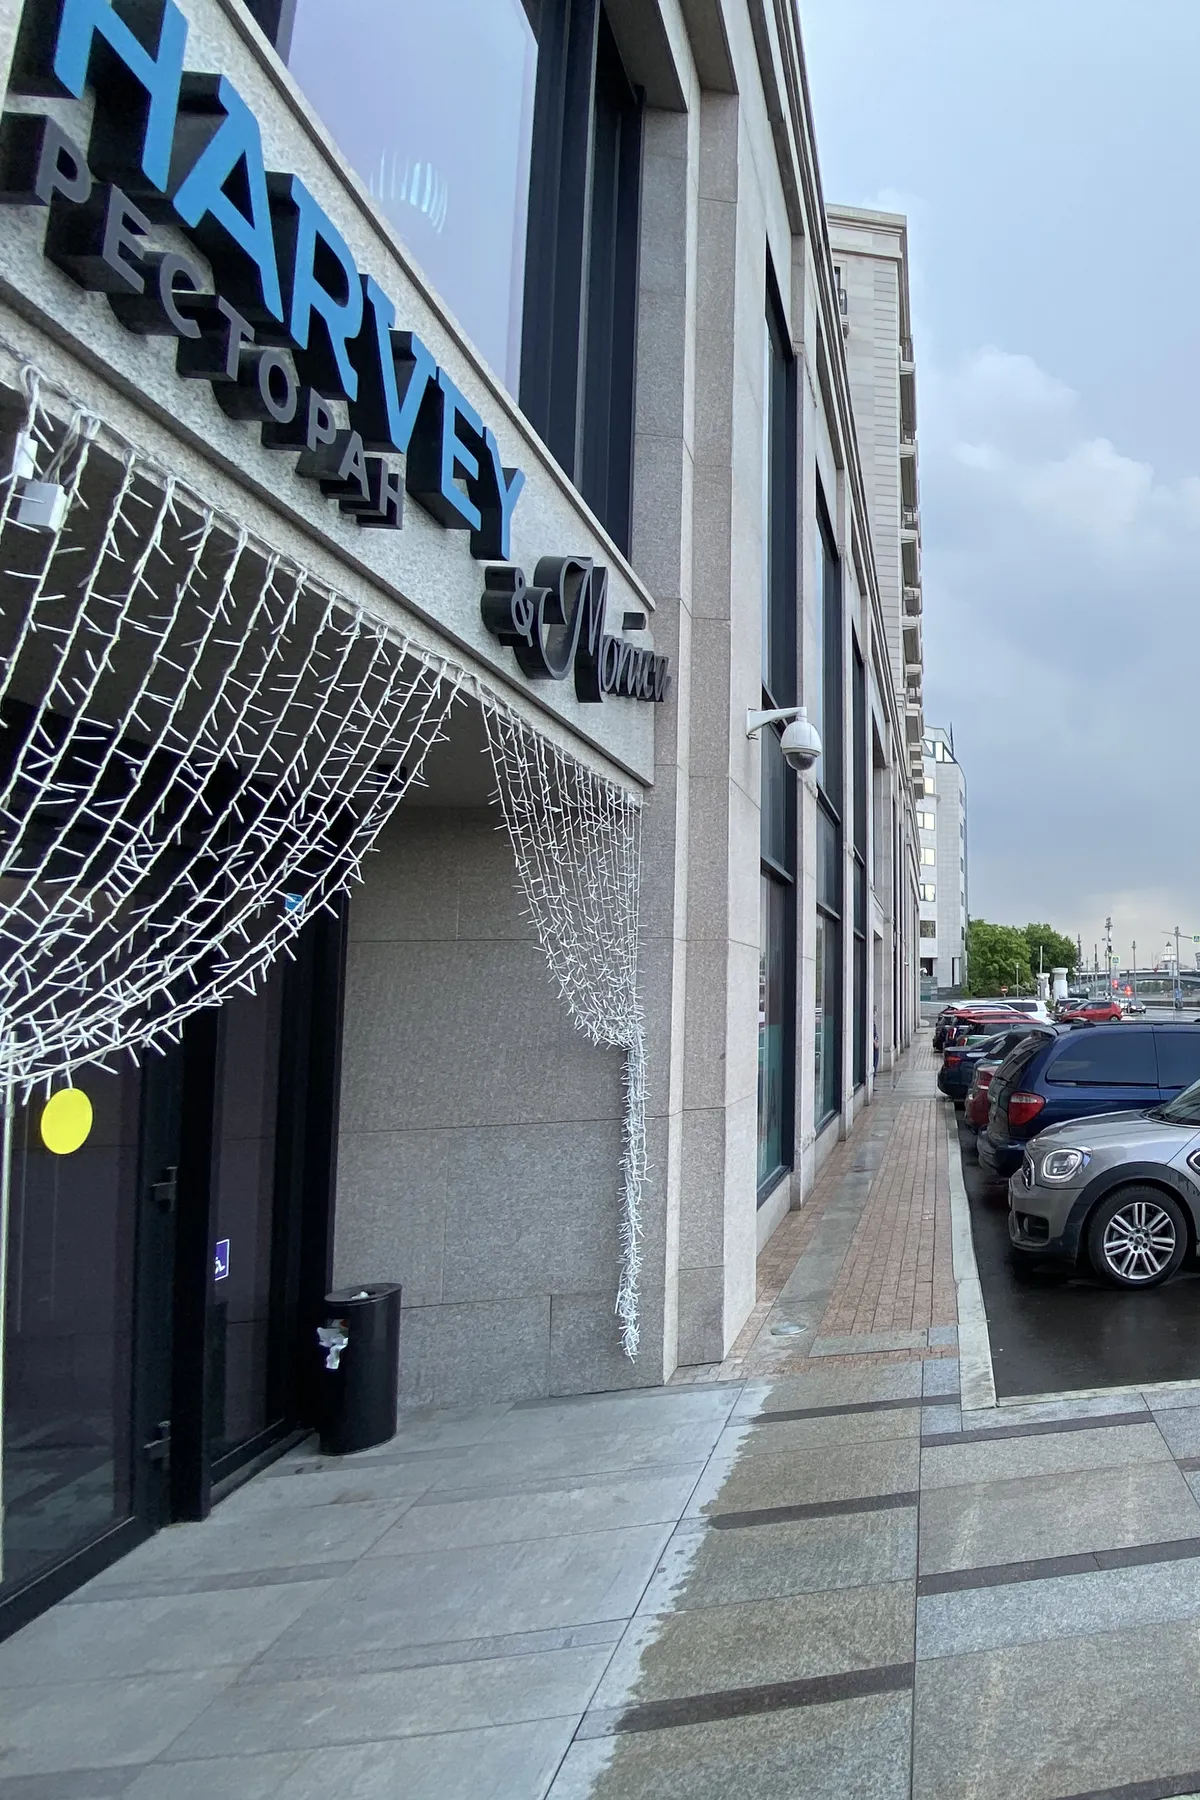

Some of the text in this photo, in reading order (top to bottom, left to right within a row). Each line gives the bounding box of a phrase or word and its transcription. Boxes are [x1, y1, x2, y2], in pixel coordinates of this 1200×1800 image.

[35, 114, 403, 530] РЕСТОРАН
[53, 0, 526, 561] HARVEY
[506, 566, 534, 648] &
